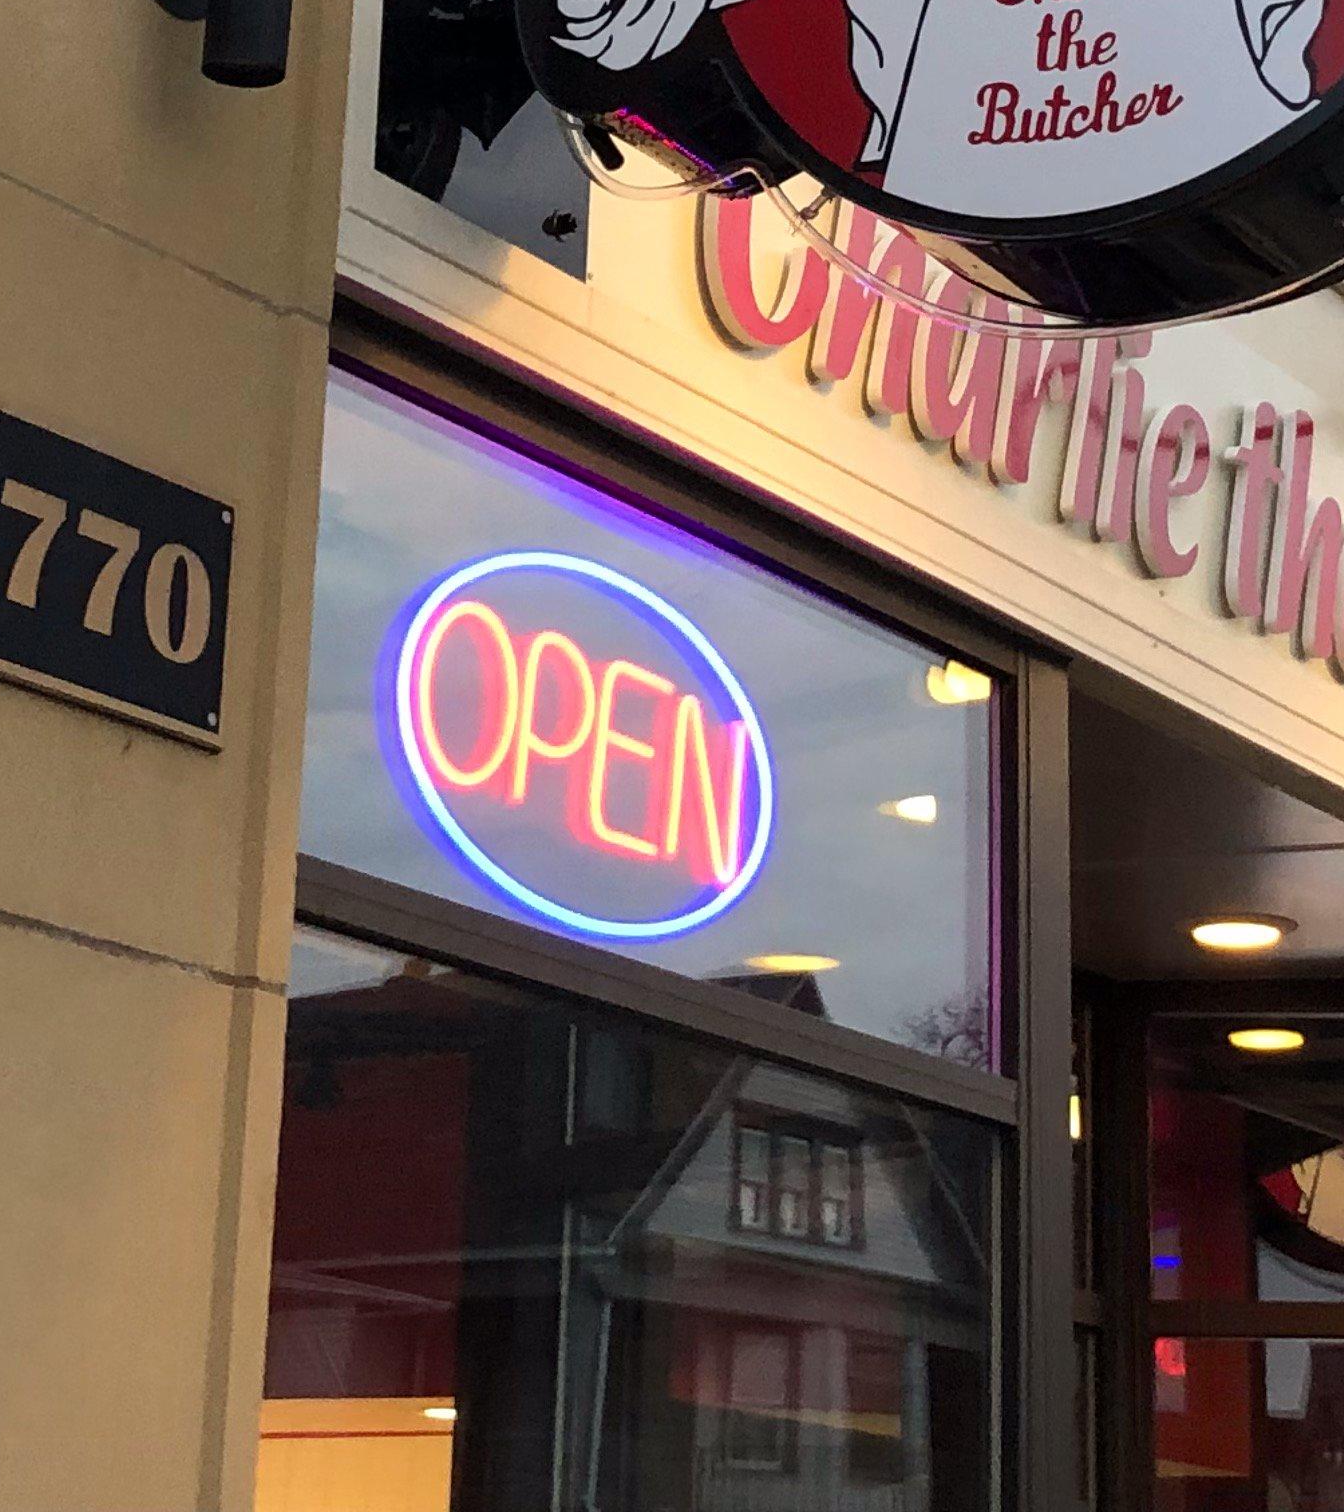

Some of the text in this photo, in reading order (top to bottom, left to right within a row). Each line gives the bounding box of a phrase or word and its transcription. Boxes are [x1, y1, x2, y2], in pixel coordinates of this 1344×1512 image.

[1036, 8, 1118, 72] the
[967, 70, 1184, 145] Butcher
[0, 478, 212, 665] 770
[414, 599, 750, 888] OPEN
